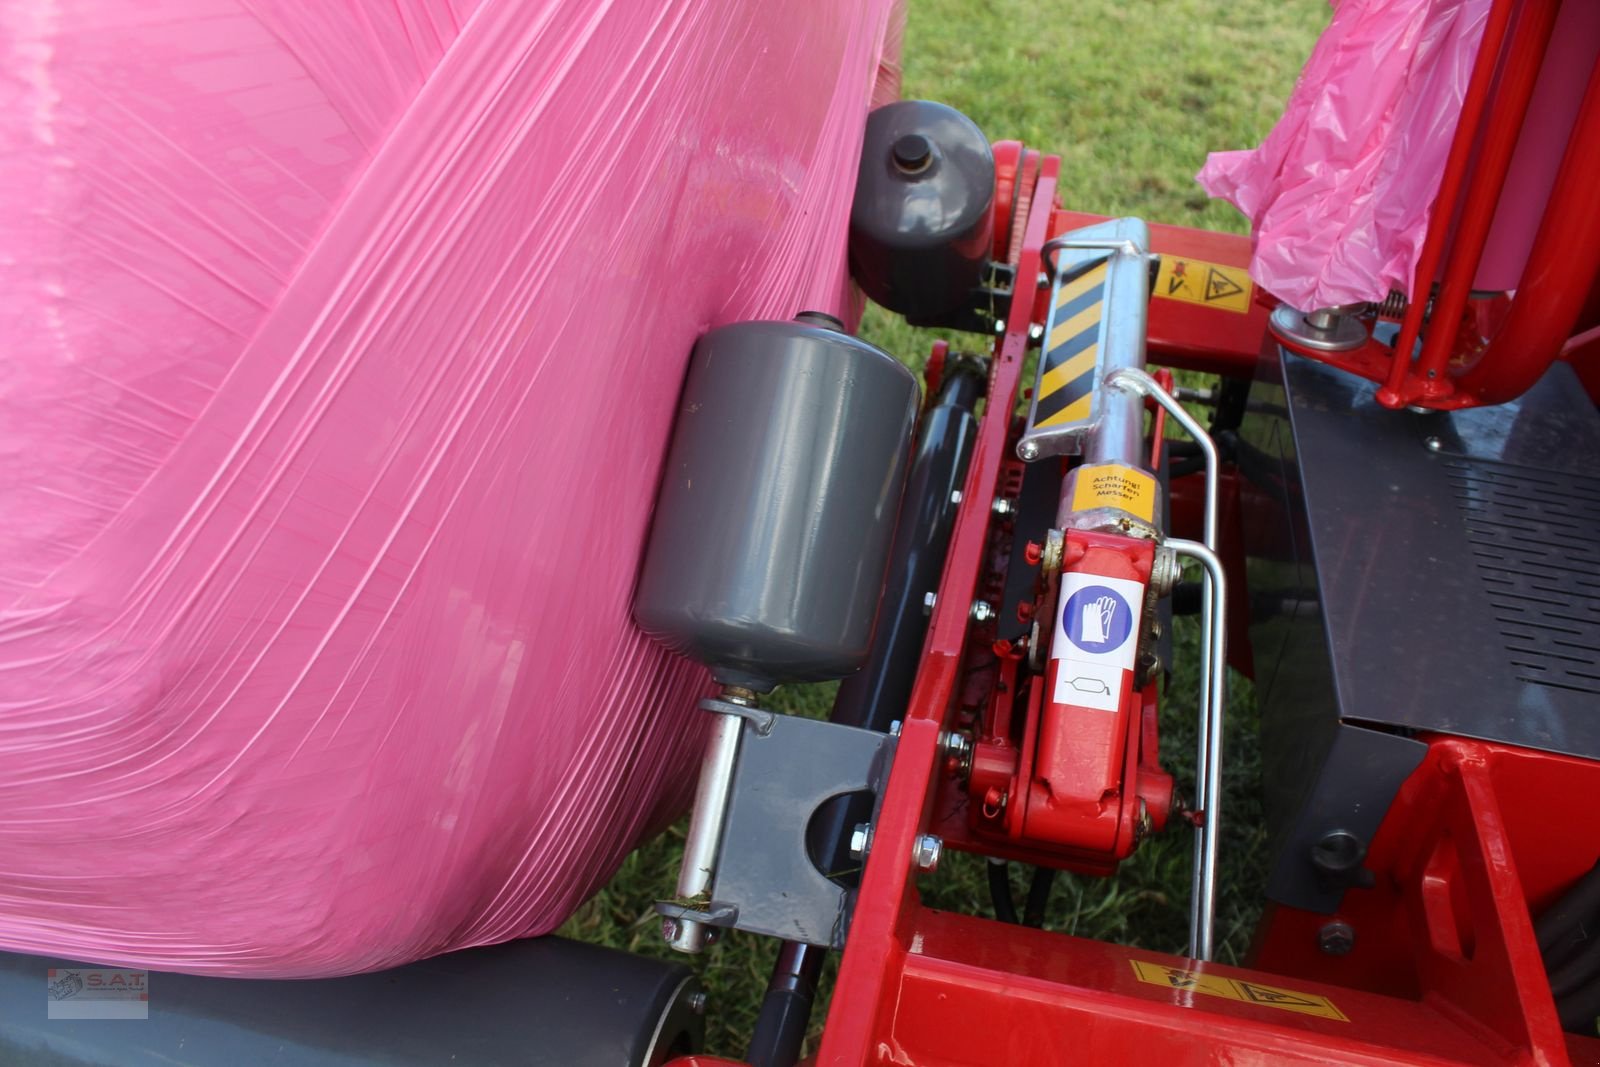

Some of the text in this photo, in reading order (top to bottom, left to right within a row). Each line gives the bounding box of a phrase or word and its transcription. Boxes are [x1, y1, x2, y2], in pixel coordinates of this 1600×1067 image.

[1093, 476, 1140, 489] Achtung!
[1093, 483, 1140, 496] Scharfen
[1096, 490, 1133, 501] Messer
